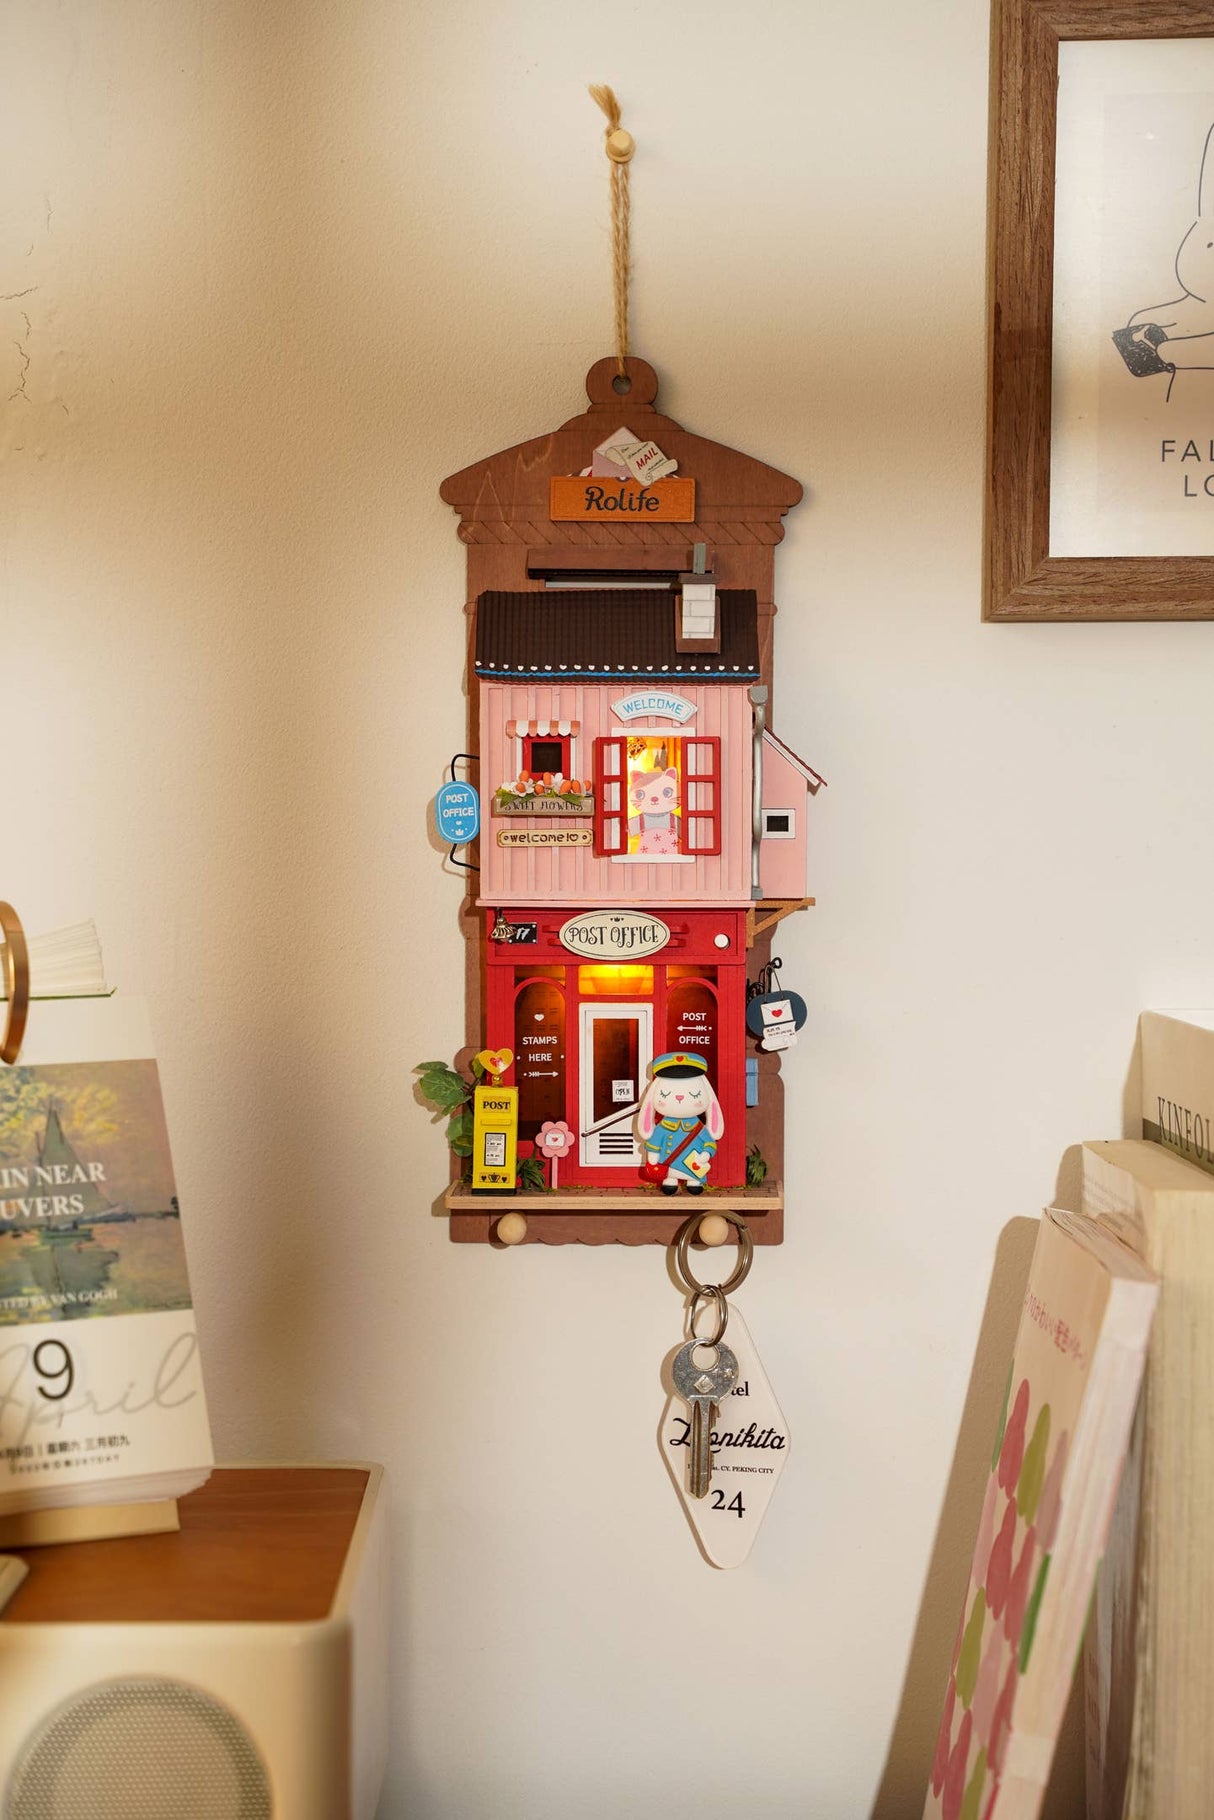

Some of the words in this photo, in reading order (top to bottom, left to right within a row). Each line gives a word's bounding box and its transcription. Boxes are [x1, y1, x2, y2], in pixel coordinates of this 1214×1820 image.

[635, 447, 659, 470] MAIL
[585, 486, 660, 512] Rolife
[622, 698, 684, 715] WELCOME
[445, 793, 469, 803] POST
[443, 807, 475, 818] OFFICE
[568, 926, 607, 945] POST
[610, 924, 659, 948] OFFICE
[682, 1012, 707, 1021] POST
[522, 1036, 558, 1045] STAMPS
[678, 1036, 711, 1045] OFFICE
[528, 1053, 553, 1062] HERE
[482, 1100, 511, 1110] POST
[33, 1162, 107, 1186] NEAR
[33, 1339, 75, 1401] 9
[732, 1466, 758, 1474] PEKING
[711, 1489, 746, 1518] 24
